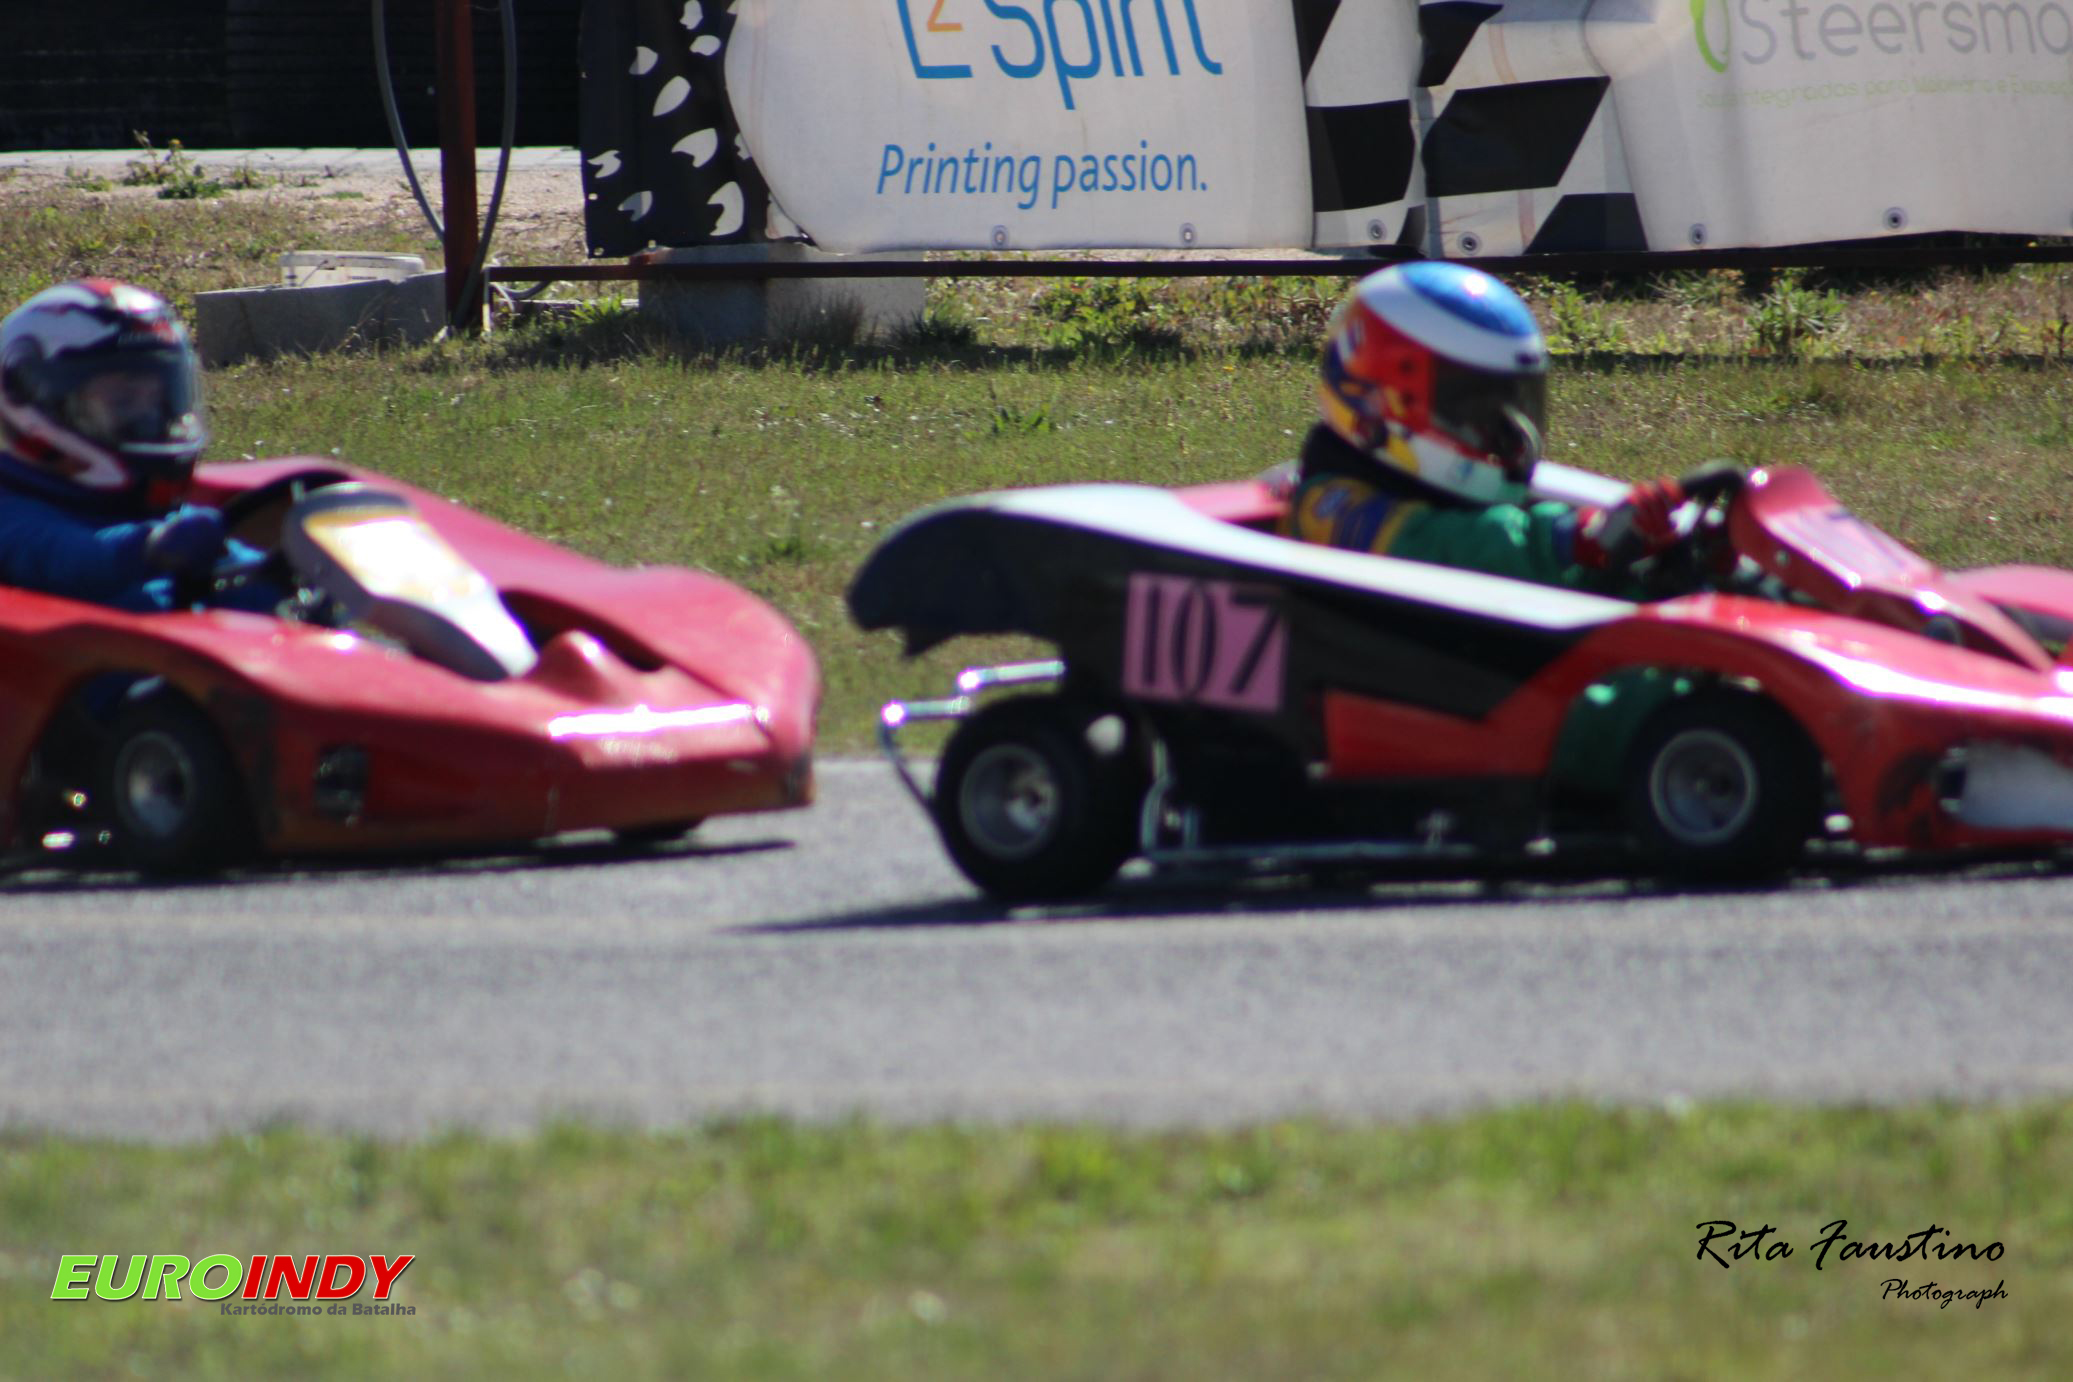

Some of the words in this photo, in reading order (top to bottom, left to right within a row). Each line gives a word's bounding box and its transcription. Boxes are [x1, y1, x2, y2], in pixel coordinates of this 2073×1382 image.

[876, 141, 1041, 210] Printing
[1052, 140, 1208, 210] passion.
[1141, 580, 1286, 696] 107
